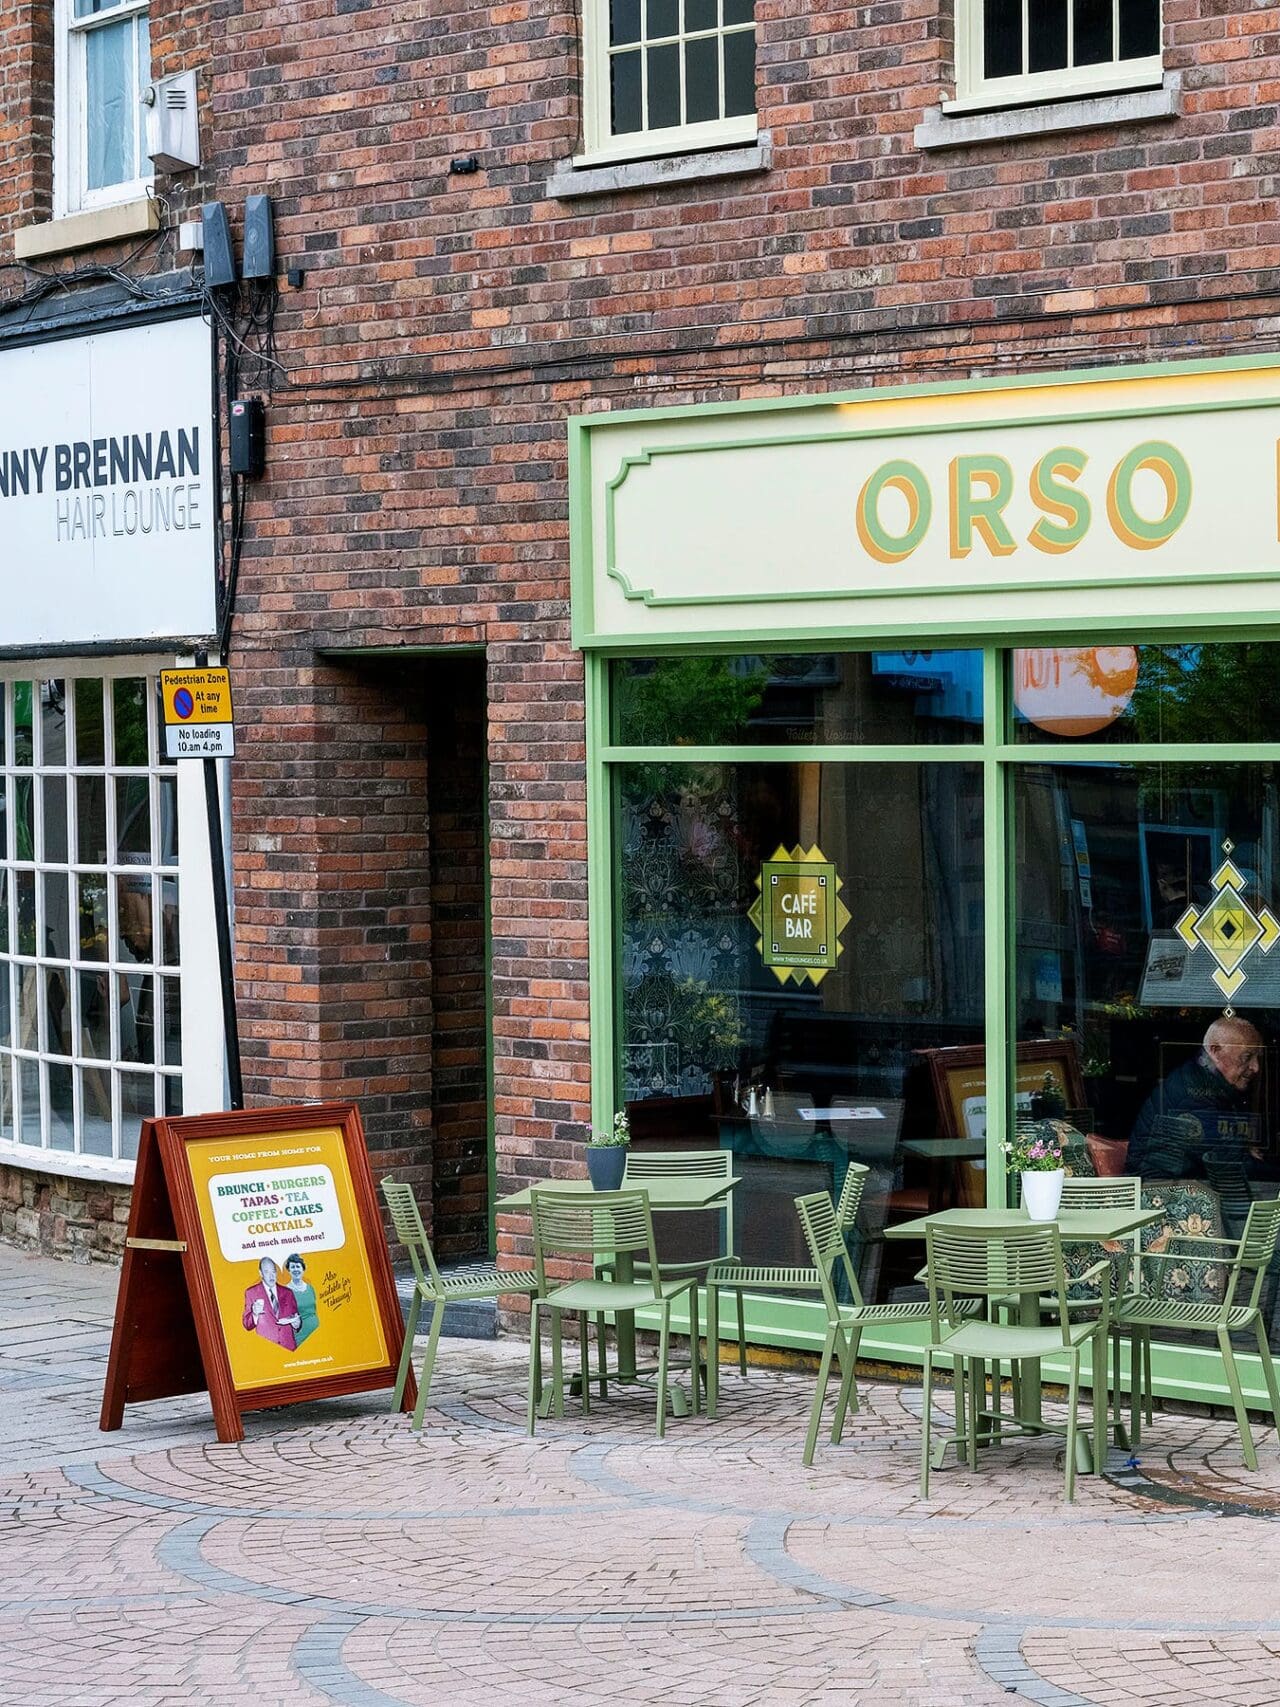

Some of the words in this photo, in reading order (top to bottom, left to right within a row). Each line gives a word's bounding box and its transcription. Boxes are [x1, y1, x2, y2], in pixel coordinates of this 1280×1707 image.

[0, 446, 48, 497] NNY
[55, 427, 200, 491] BRENNAN
[856, 439, 1193, 564] ORSO
[56, 494, 106, 541] HAIR
[112, 483, 201, 536] LOUNGE
[164, 674, 205, 685] Pedestrian
[207, 673, 226, 684] Zone
[195, 691, 205, 701] At
[207, 692, 220, 702] any
[200, 704, 218, 713] time
[178, 728, 190, 739] No
[192, 728, 221, 740] loading
[178, 741, 201, 752] 10.am
[203, 741, 223, 752] 4.pm
[781, 889, 817, 915] CAFÉ
[785, 918, 812, 938] BAR
[208, 1155, 231, 1163] YOUR
[233, 1152, 256, 1161] HOME
[257, 1149, 280, 1158] FROM
[281, 1147, 304, 1155] HOME
[306, 1145, 322, 1153] FOR
[217, 1182, 265, 1196] BRUNCH
[271, 1175, 326, 1190] BURGERS
[240, 1194, 279, 1208] TAPAS
[285, 1191, 310, 1203] TEA
[232, 1208, 278, 1222] COFFEE
[285, 1203, 323, 1216] CAKES
[247, 1218, 314, 1235] COCKTAILS
[241, 1240, 256, 1249] and
[258, 1238, 279, 1247] much
[281, 1235, 302, 1245] much
[303, 1232, 325, 1242] more!
[322, 1271, 337, 1285] Also
